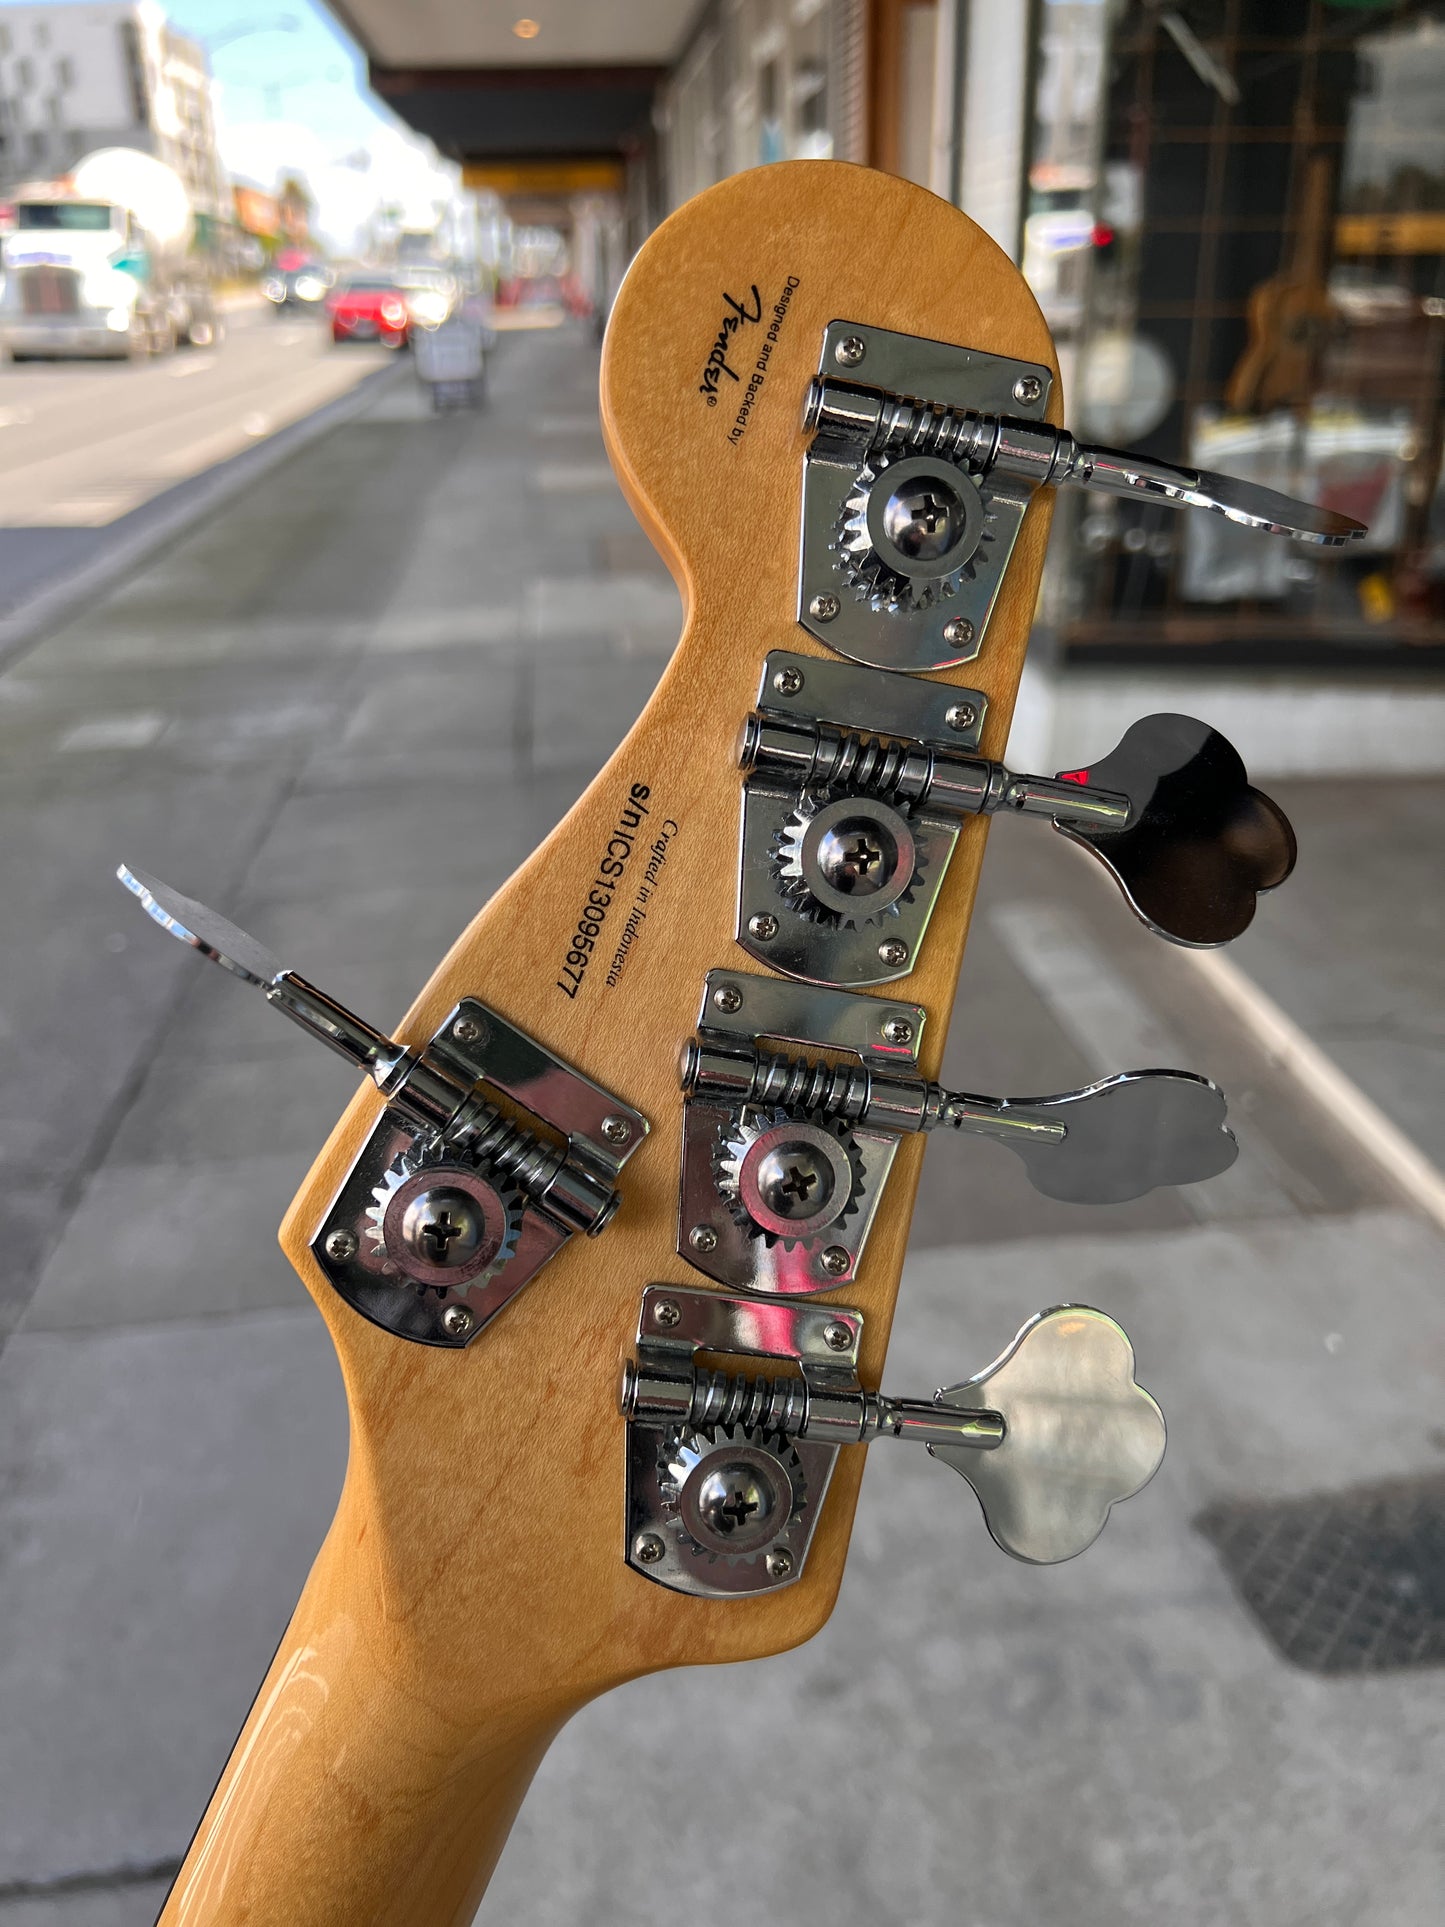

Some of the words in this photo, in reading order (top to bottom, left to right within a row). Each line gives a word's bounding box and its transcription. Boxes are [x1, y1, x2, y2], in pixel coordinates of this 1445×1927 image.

[767, 275, 800, 342] Designed
[756, 345, 773, 371] and
[736, 374, 764, 426] Backed
[727, 428, 745, 446] by
[644, 819, 678, 886] Crafted
[637, 886, 653, 902] in
[606, 907, 646, 988] Indonesia
